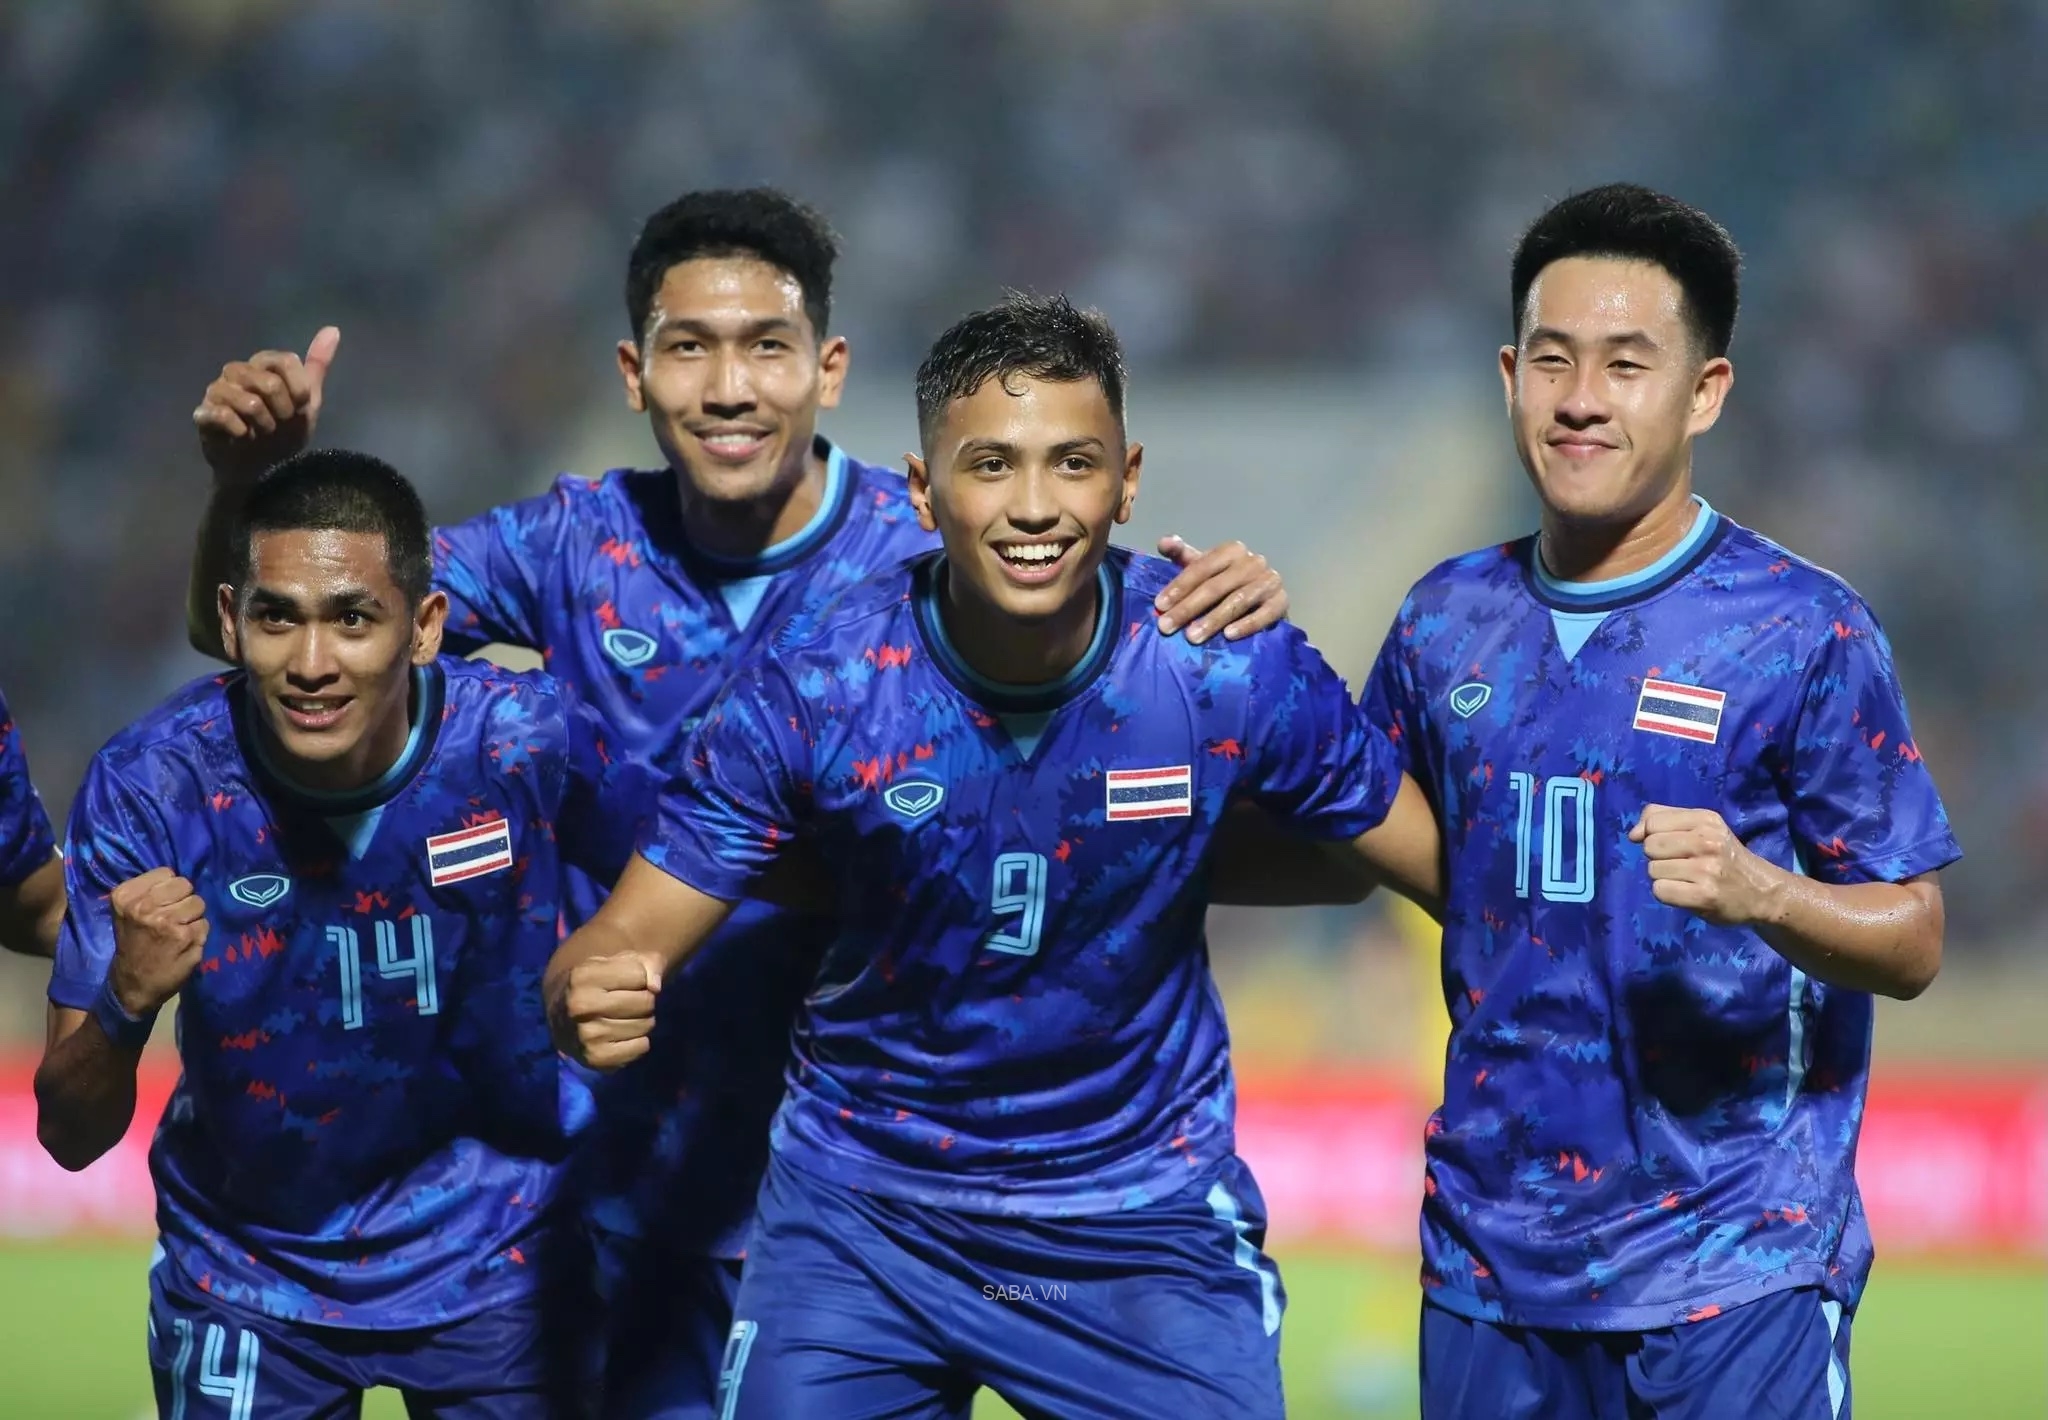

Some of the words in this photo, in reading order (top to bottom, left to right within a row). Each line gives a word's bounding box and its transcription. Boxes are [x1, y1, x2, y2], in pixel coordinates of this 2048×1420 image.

[1509, 771, 1595, 903] 10
[984, 852, 1048, 956] 9
[325, 913, 439, 1031] 14
[171, 1318, 260, 1420] 14
